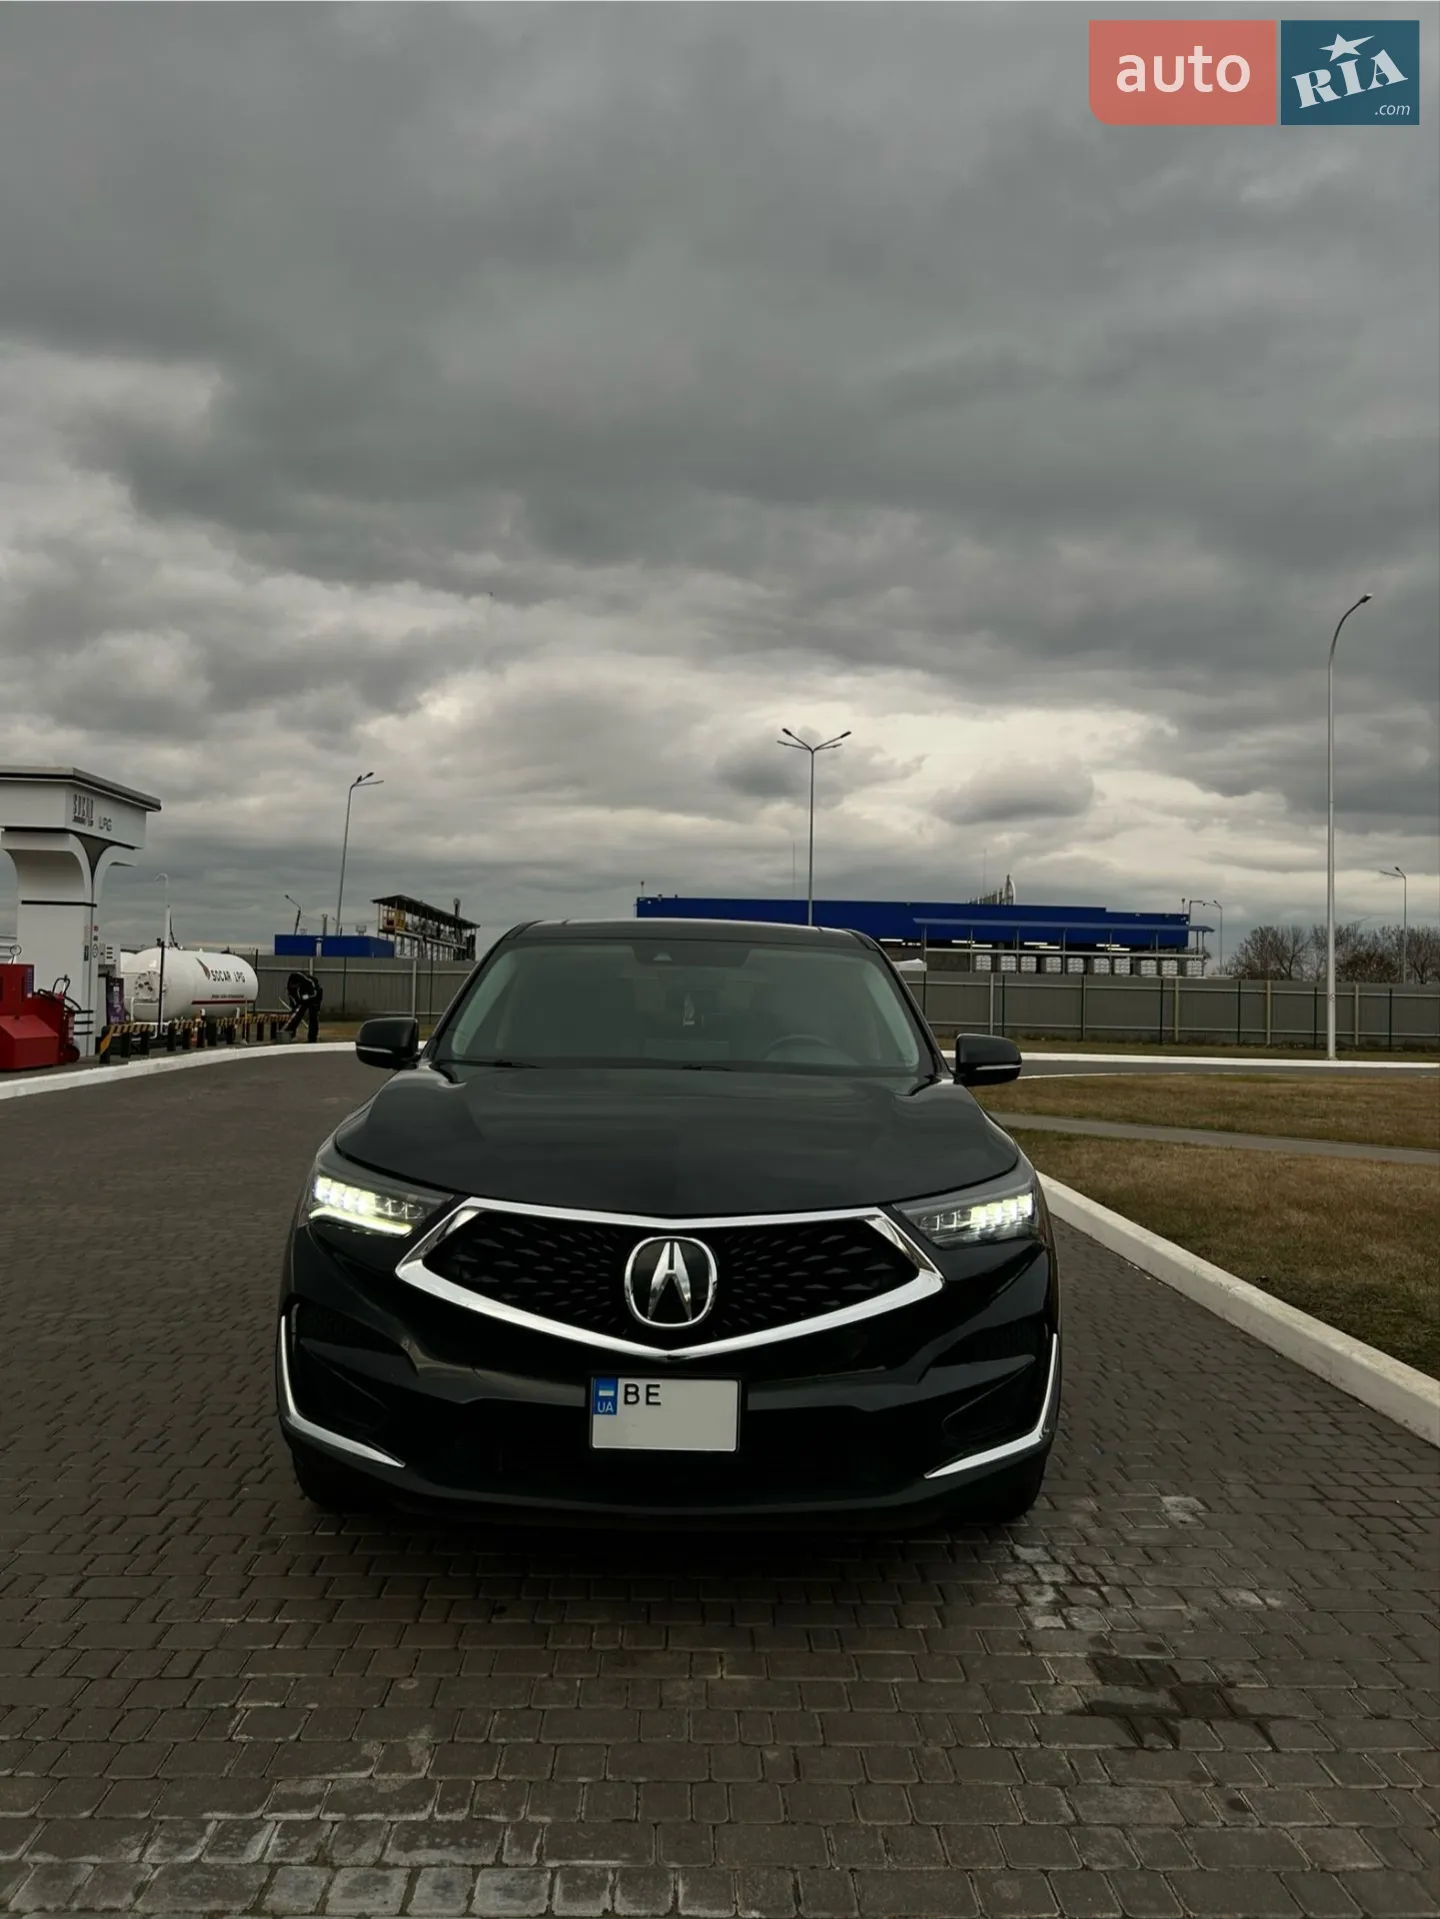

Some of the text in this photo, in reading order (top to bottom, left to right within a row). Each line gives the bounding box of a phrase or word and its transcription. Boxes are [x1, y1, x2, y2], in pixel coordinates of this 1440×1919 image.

[99, 816, 112, 831] LPG
[211, 969, 232, 982] SOCAR
[623, 1383, 662, 1406] BE
[597, 1401, 615, 1413] UA
